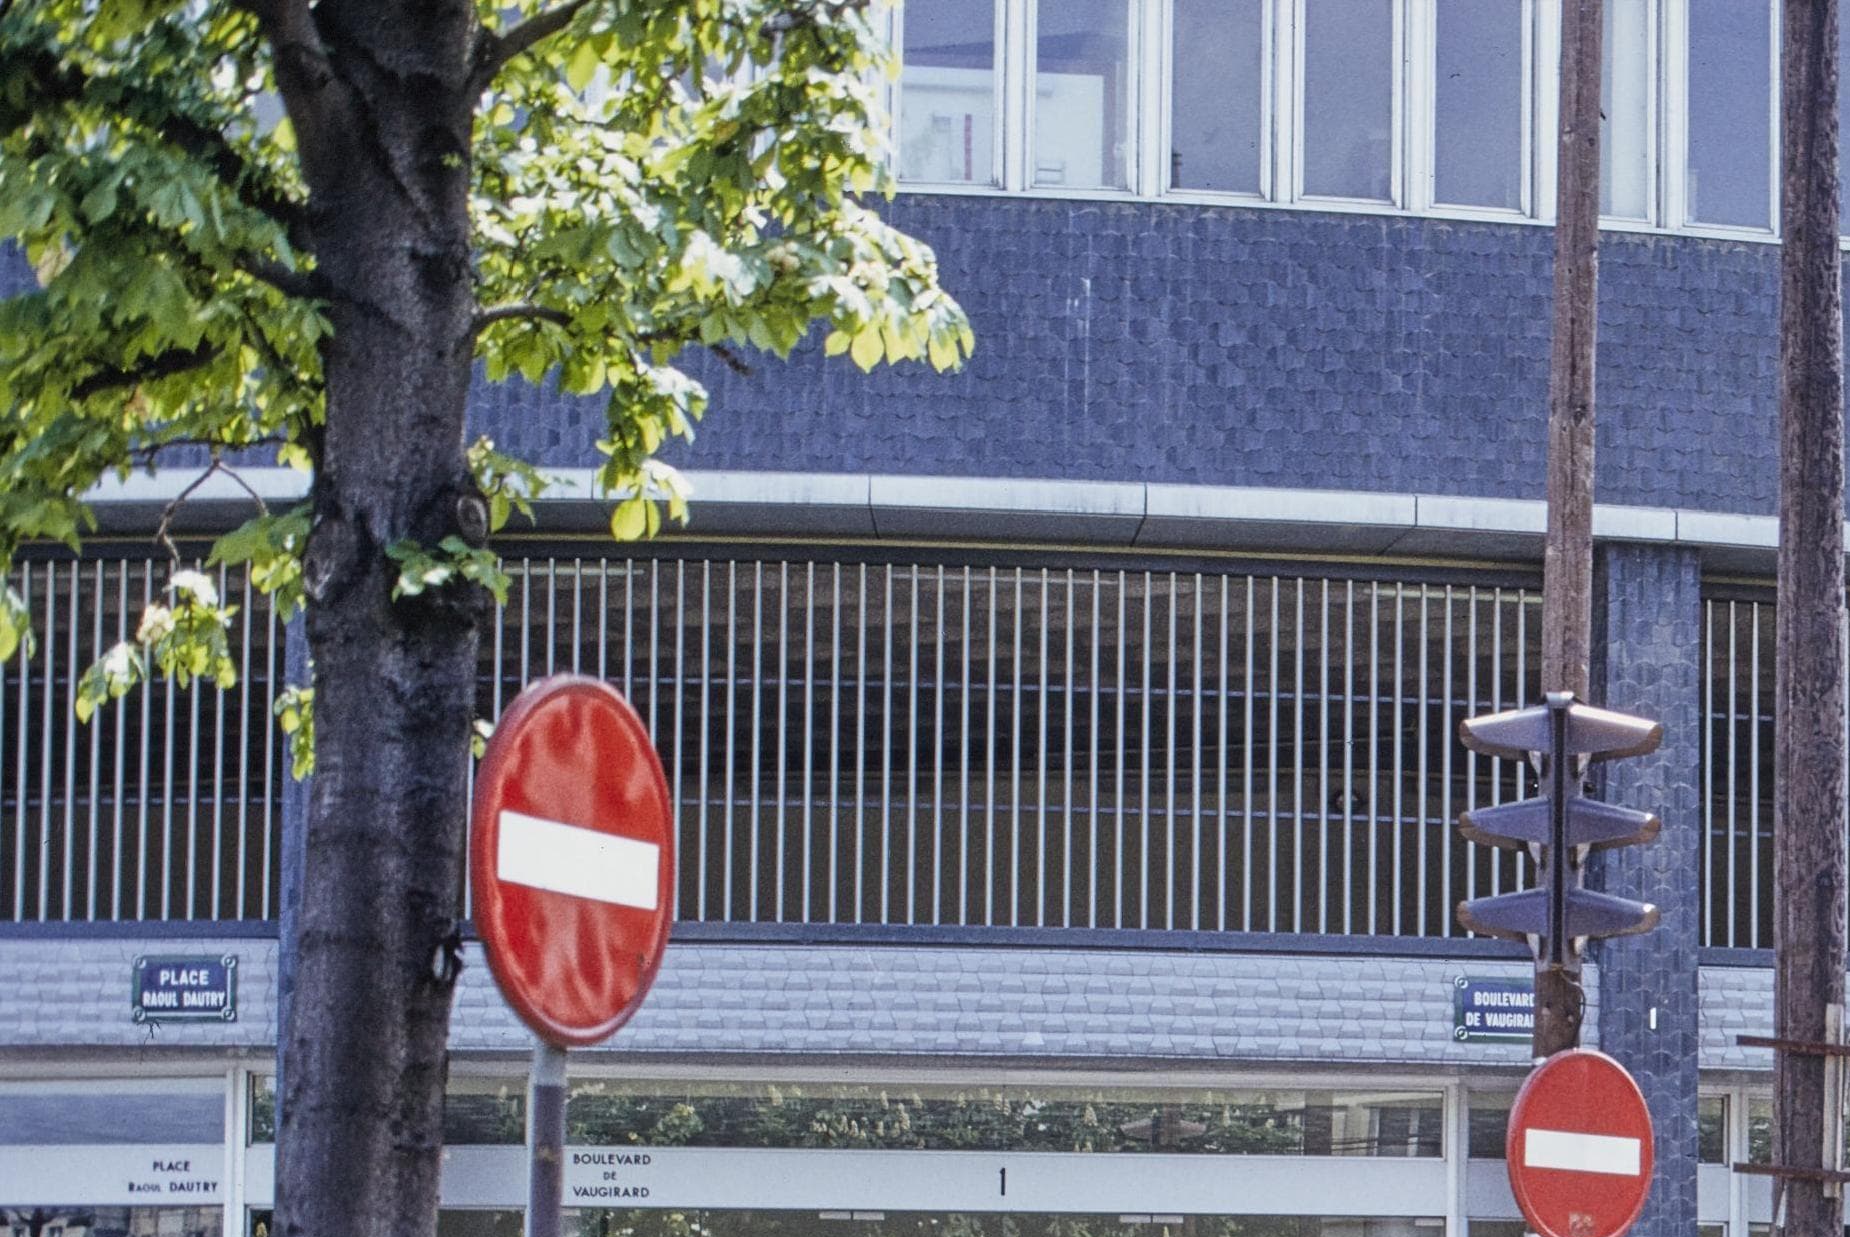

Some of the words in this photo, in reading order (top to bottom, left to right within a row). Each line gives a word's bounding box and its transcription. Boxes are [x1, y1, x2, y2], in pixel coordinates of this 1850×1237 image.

[160, 969, 210, 986] PLACE
[142, 991, 178, 1008] RAOUL
[183, 991, 226, 1008] DAUTRY
[1465, 1012, 1481, 1026] DE
[573, 1153, 652, 1165] BOULEVARD
[152, 1161, 191, 1172] PLACE
[603, 1171, 617, 1181] DE
[1000, 1167, 1006, 1196] 1
[169, 1182, 218, 1192] DAUTRY
[572, 1186, 651, 1198] VAUGIRARD
